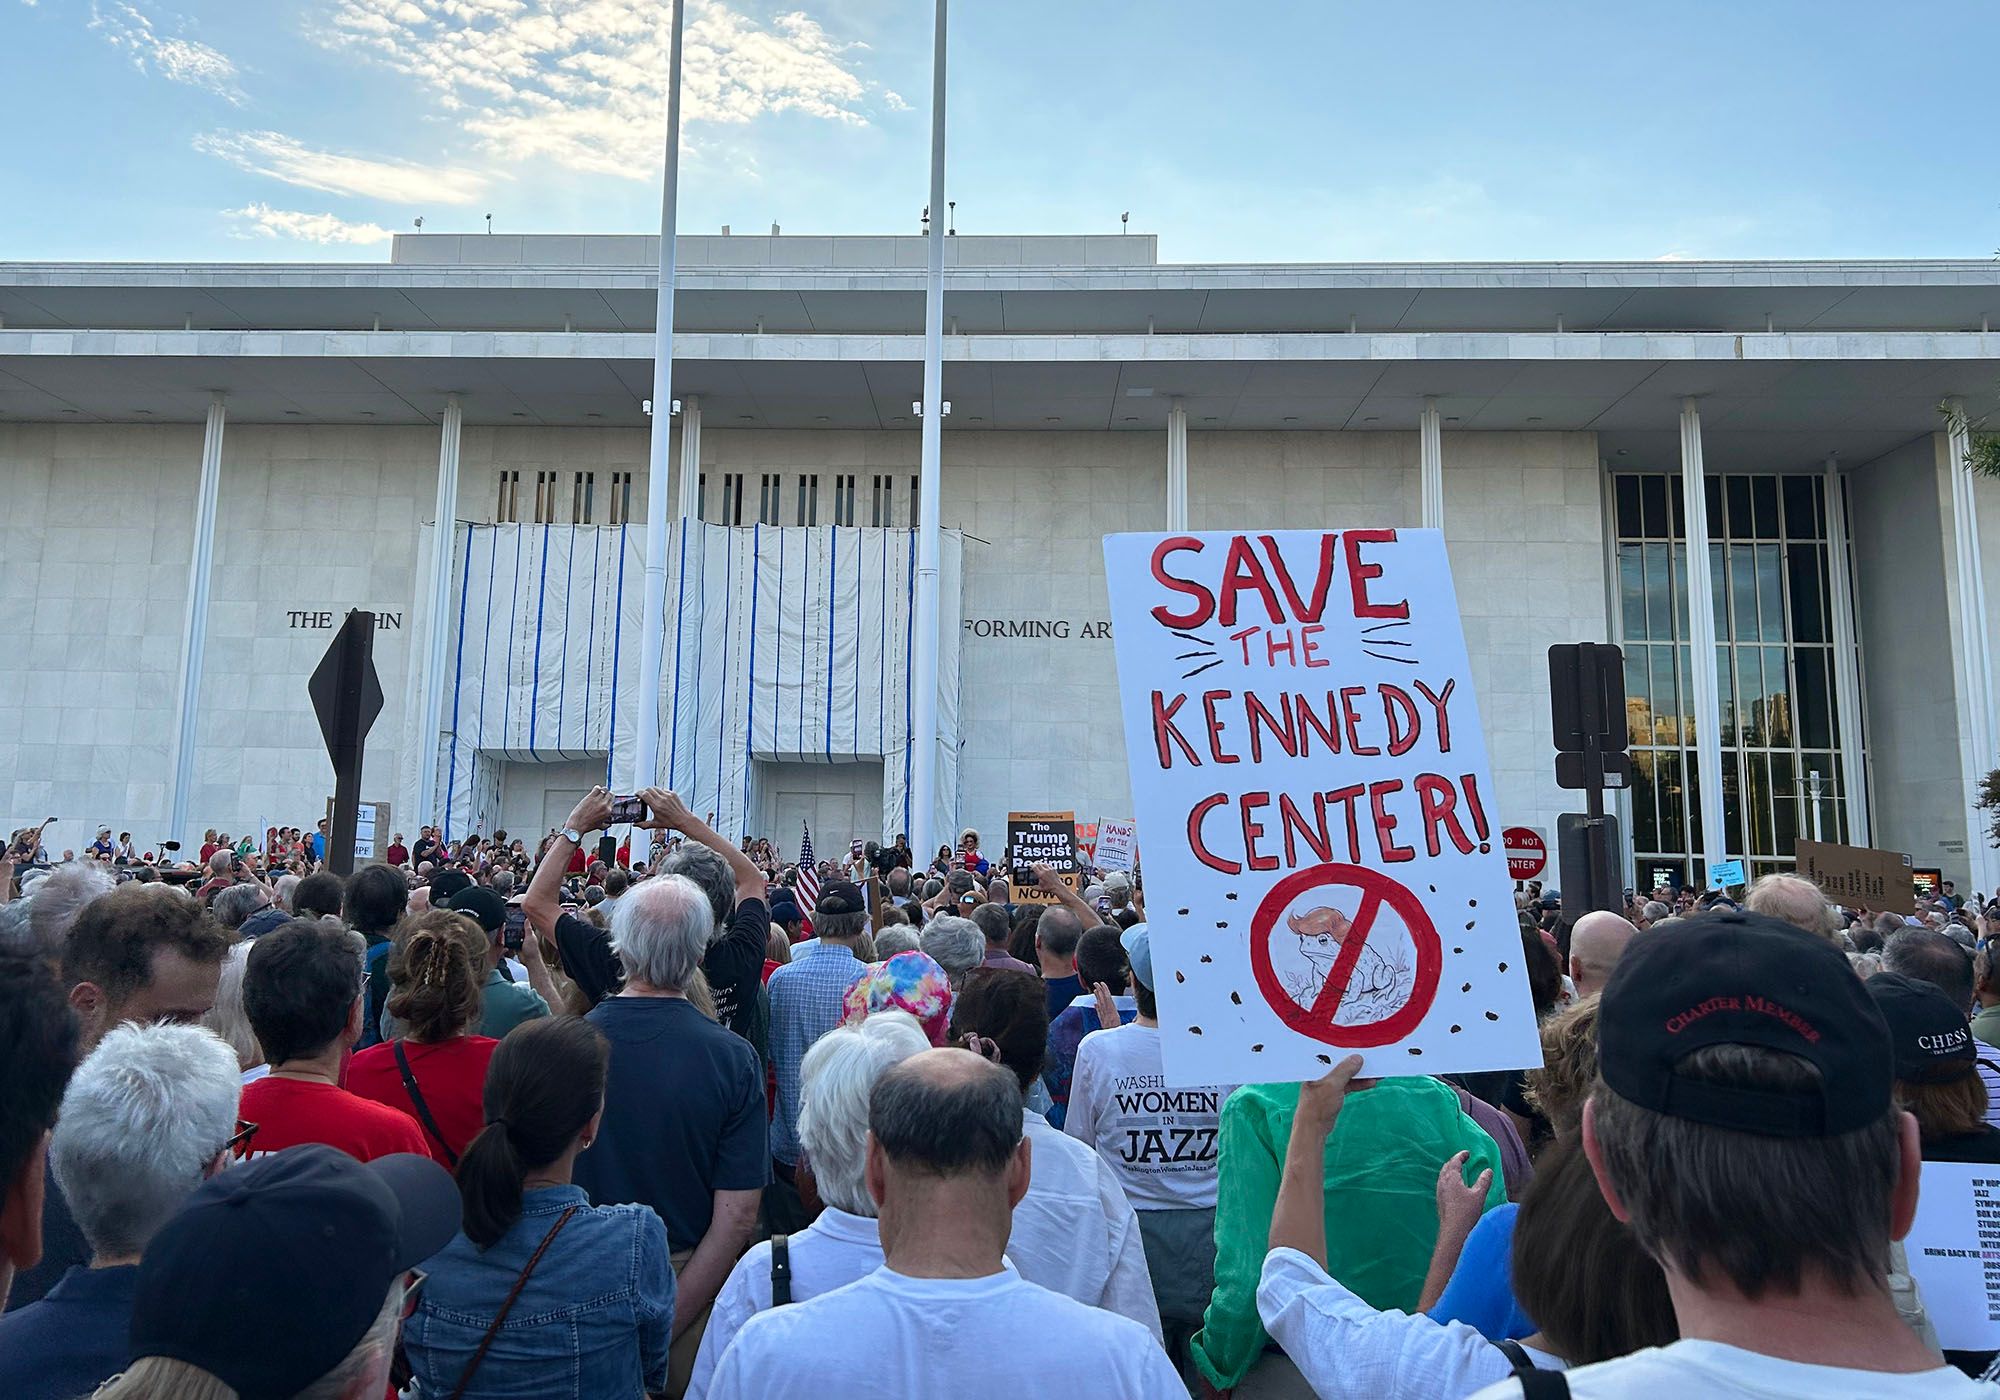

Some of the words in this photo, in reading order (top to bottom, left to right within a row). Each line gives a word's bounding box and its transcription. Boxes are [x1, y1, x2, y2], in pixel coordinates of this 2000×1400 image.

[1151, 529, 1409, 630] SAVE
[287, 611, 333, 629] THE
[1080, 621, 1113, 639] AR
[1230, 625, 1330, 668] THE
[1151, 678, 1456, 769] KENNEDY
[1030, 822, 1050, 831] The
[1106, 824, 1132, 837] HANDS
[1187, 773, 1491, 875] CENTER!
[1015, 831, 1068, 846] Trump
[1521, 838, 1539, 846] NOT
[1012, 844, 1072, 857] Fascist
[1665, 997, 1741, 1034] CHARTER
[1744, 995, 1821, 1044] MEMBER
[1917, 1027, 1968, 1050] CHESS
[1115, 1091, 1219, 1115] WOMEN
[1163, 1116, 1174, 1125] IN
[1120, 1129, 1219, 1163] JAZZ
[1972, 1179, 1985, 1187] HIP
[1973, 1189, 1990, 1198] JAZZ
[1976, 1209, 1991, 1218] BOX
[1924, 1247, 1946, 1257] BRING
[1947, 1248, 1967, 1258] BACK
[1967, 1250, 1981, 1259] THE
